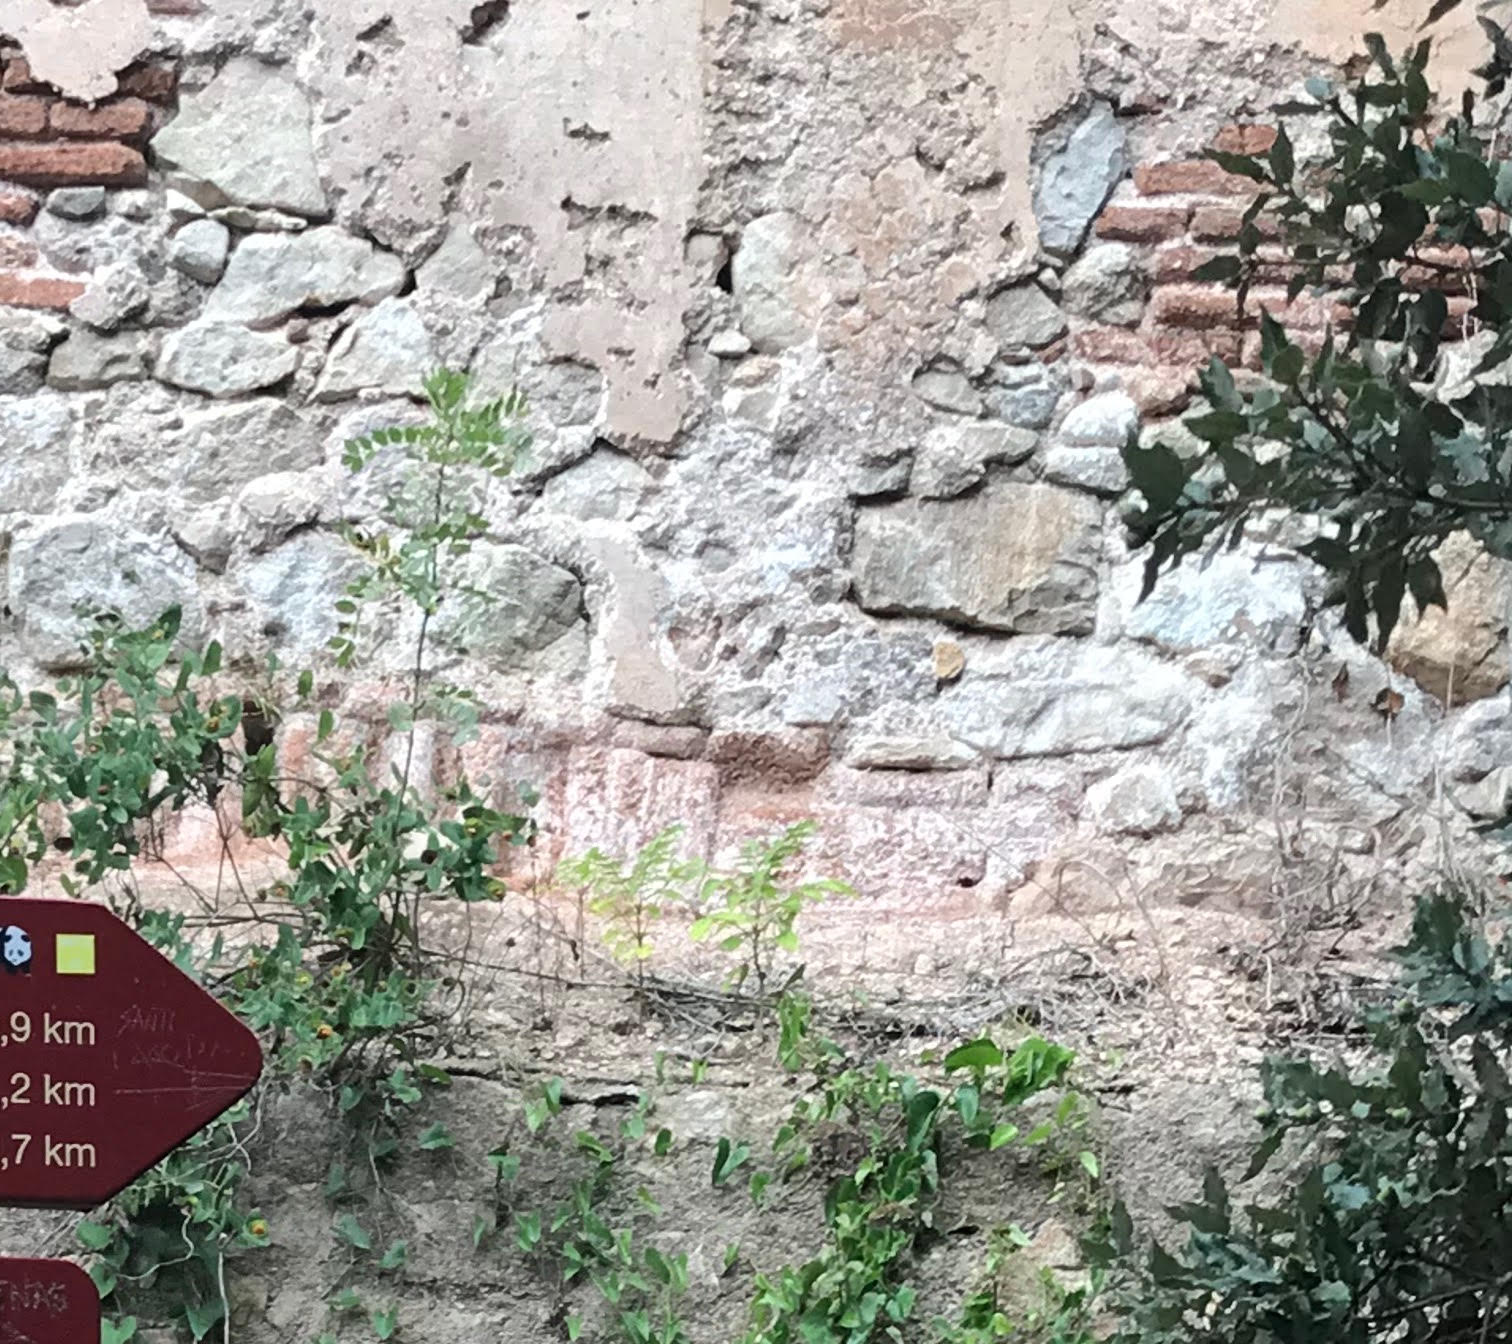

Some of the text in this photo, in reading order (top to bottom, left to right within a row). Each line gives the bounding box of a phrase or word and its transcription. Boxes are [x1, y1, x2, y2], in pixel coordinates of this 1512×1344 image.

[43, 1012, 96, 1046] km
[43, 1074, 96, 1106] km
[44, 1136, 97, 1168] km
